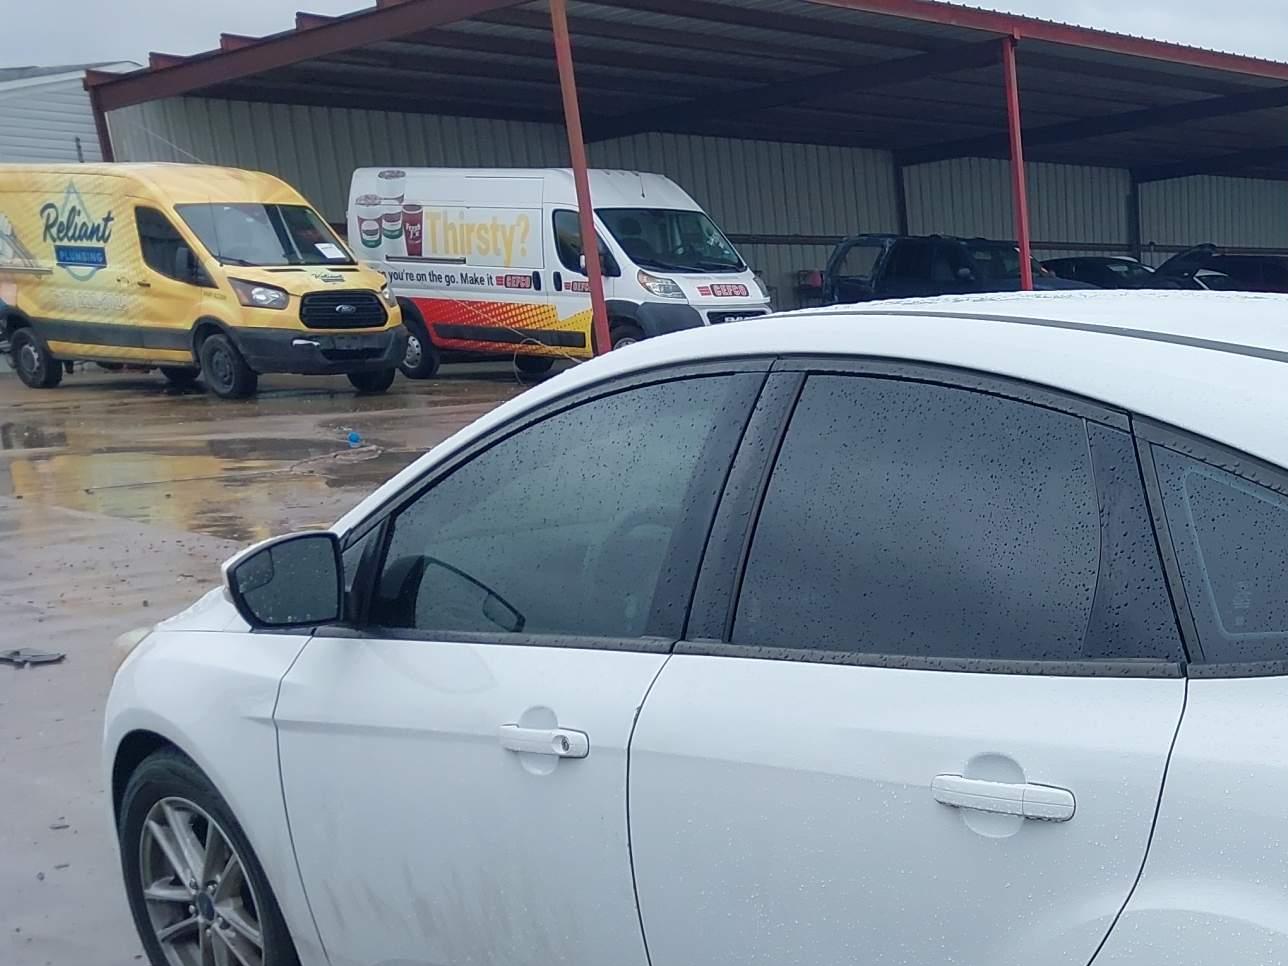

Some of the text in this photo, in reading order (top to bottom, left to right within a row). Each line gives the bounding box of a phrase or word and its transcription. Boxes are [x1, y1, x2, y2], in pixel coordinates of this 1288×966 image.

[40, 203, 114, 243] Reliant
[425, 208, 529, 267] Thirsty?
[388, 269, 415, 283] you're
[416, 272, 427, 282] on
[428, 270, 443, 283] the
[445, 274, 458, 287] go.
[460, 273, 485, 286] Make
[487, 274, 494, 286] it
[505, 275, 532, 288] CEFCO
